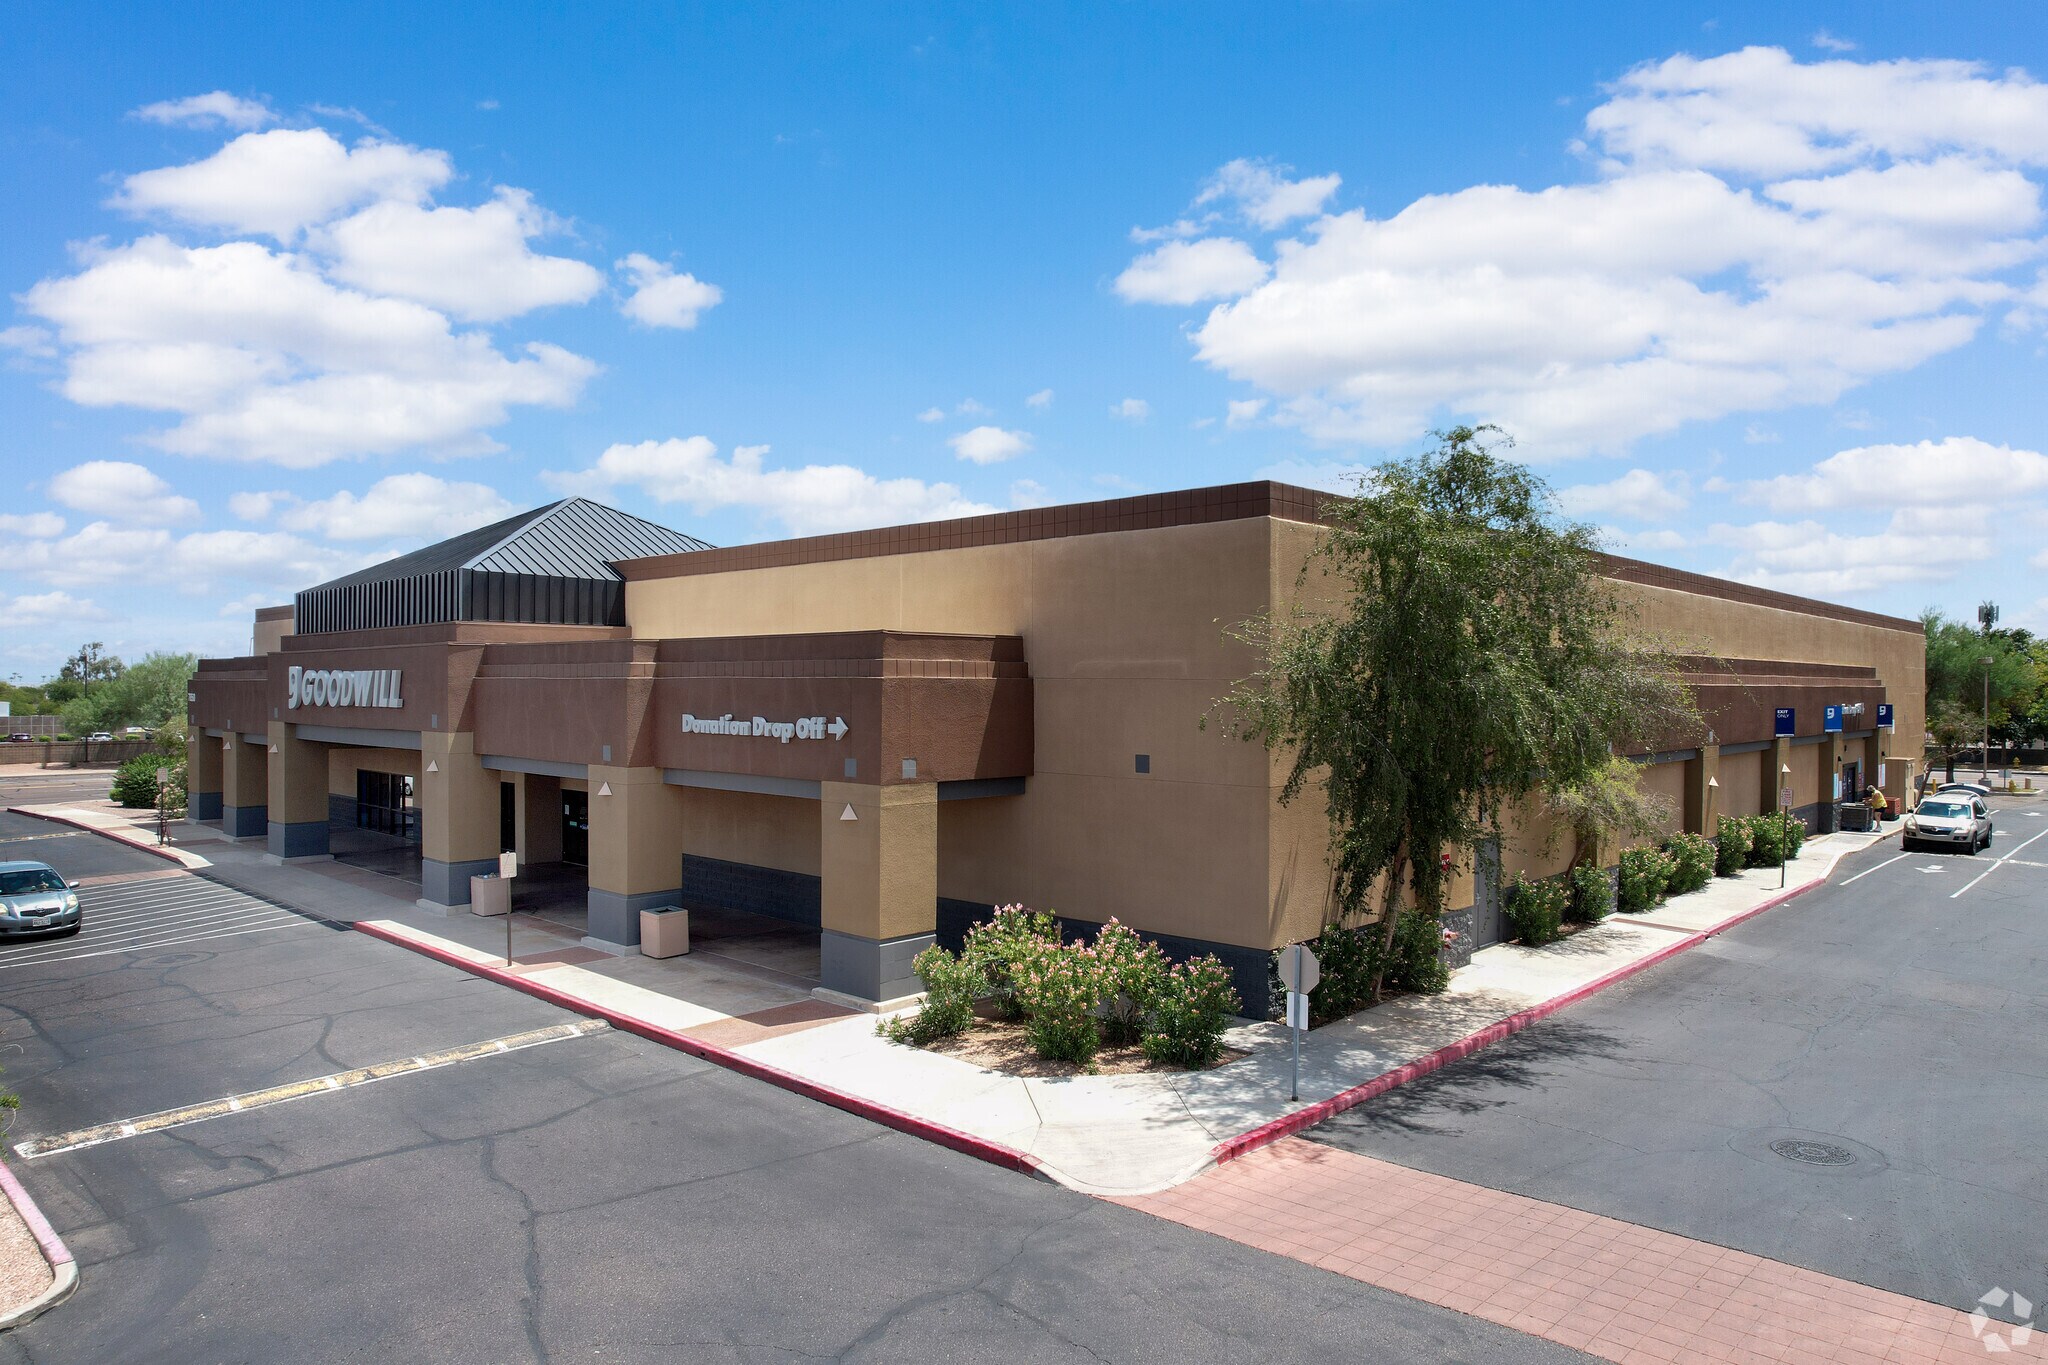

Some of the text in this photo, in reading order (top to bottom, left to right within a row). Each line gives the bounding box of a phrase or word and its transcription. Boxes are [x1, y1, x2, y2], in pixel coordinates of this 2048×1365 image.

[302, 670, 404, 708] GOODWILL
[682, 713, 827, 744] Donation Drop Off
